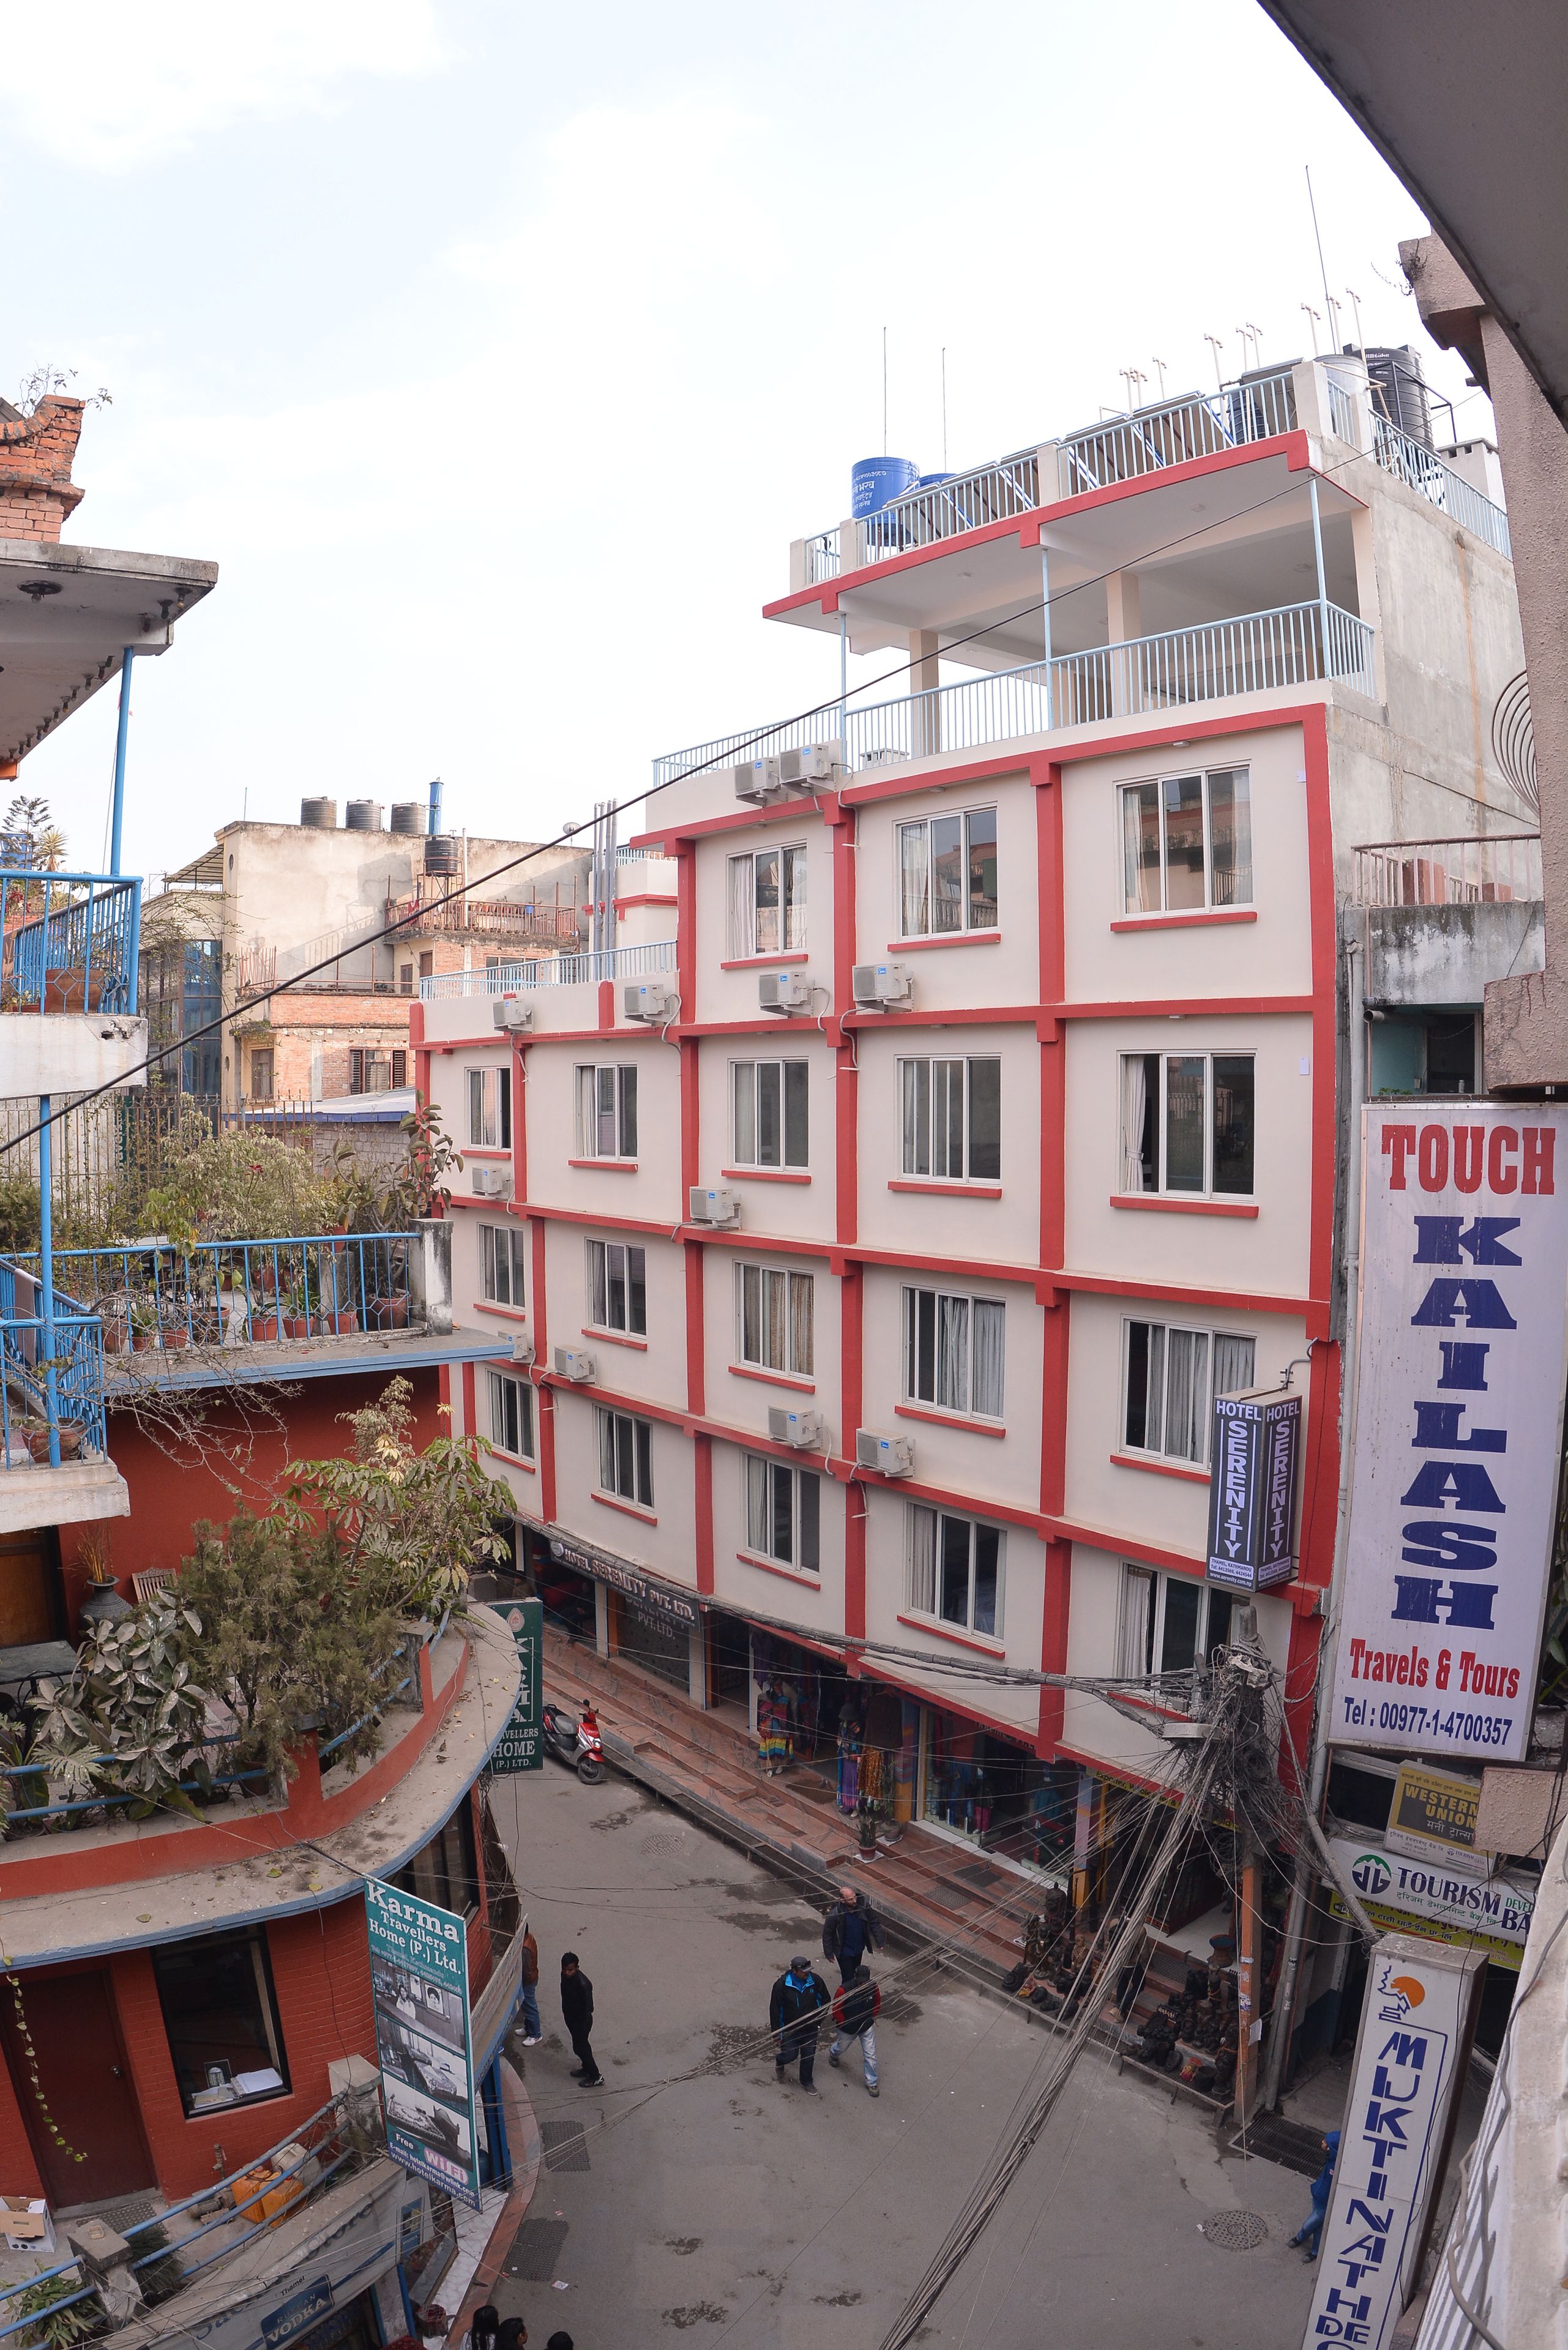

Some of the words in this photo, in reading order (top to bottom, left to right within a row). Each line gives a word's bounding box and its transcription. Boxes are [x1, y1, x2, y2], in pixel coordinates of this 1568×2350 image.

[1381, 1124, 1556, 1195] TOUCH
[1216, 1400, 1261, 1421] HOTEL
[1266, 1401, 1299, 1422] HOTEL
[1391, 1215, 1523, 1630] KAILASH
[1224, 1420, 1248, 1558] SERENITY
[1271, 1420, 1290, 1558] SERENITY
[564, 1548, 591, 1571] HOTEL
[592, 1559, 647, 1597] SERENITY
[650, 1589, 672, 1610] PVT.
[673, 1600, 695, 1621] LTD.
[1350, 1638, 1429, 1688] Travels
[1436, 1649, 1451, 1691] &
[1459, 1651, 1520, 1699] Tours
[1379, 1702, 1513, 1745] 00977-1-4700357
[493, 1740, 536, 1758] HOME
[496, 1760, 509, 1770] (P.)
[512, 1758, 532, 1767] LTD.
[1405, 1785, 1478, 1816] WESTERN
[1425, 1804, 1477, 1829] UNION
[1427, 1820, 1446, 1833] मनी
[1449, 1827, 1474, 1841] ट्रान्स
[1397, 1867, 1502, 1916] TOURISM
[367, 1881, 460, 1944] Karma
[381, 1911, 446, 1952] Travellers
[369, 1918, 406, 1947] Home
[410, 1939, 430, 1963] (P.)
[435, 1950, 461, 1975] Ltd.
[389, 2142, 409, 2158] E-mail:
[395, 2133, 414, 2150] Free
[390, 2152, 476, 2207] www.hotelkarma.com
[1326, 2031, 1428, 2322] MUKTINATH
[280, 2275, 305, 2297] Thamel
[267, 2297, 328, 2343] VODKA
[277, 2292, 316, 2324] RUSLAN
